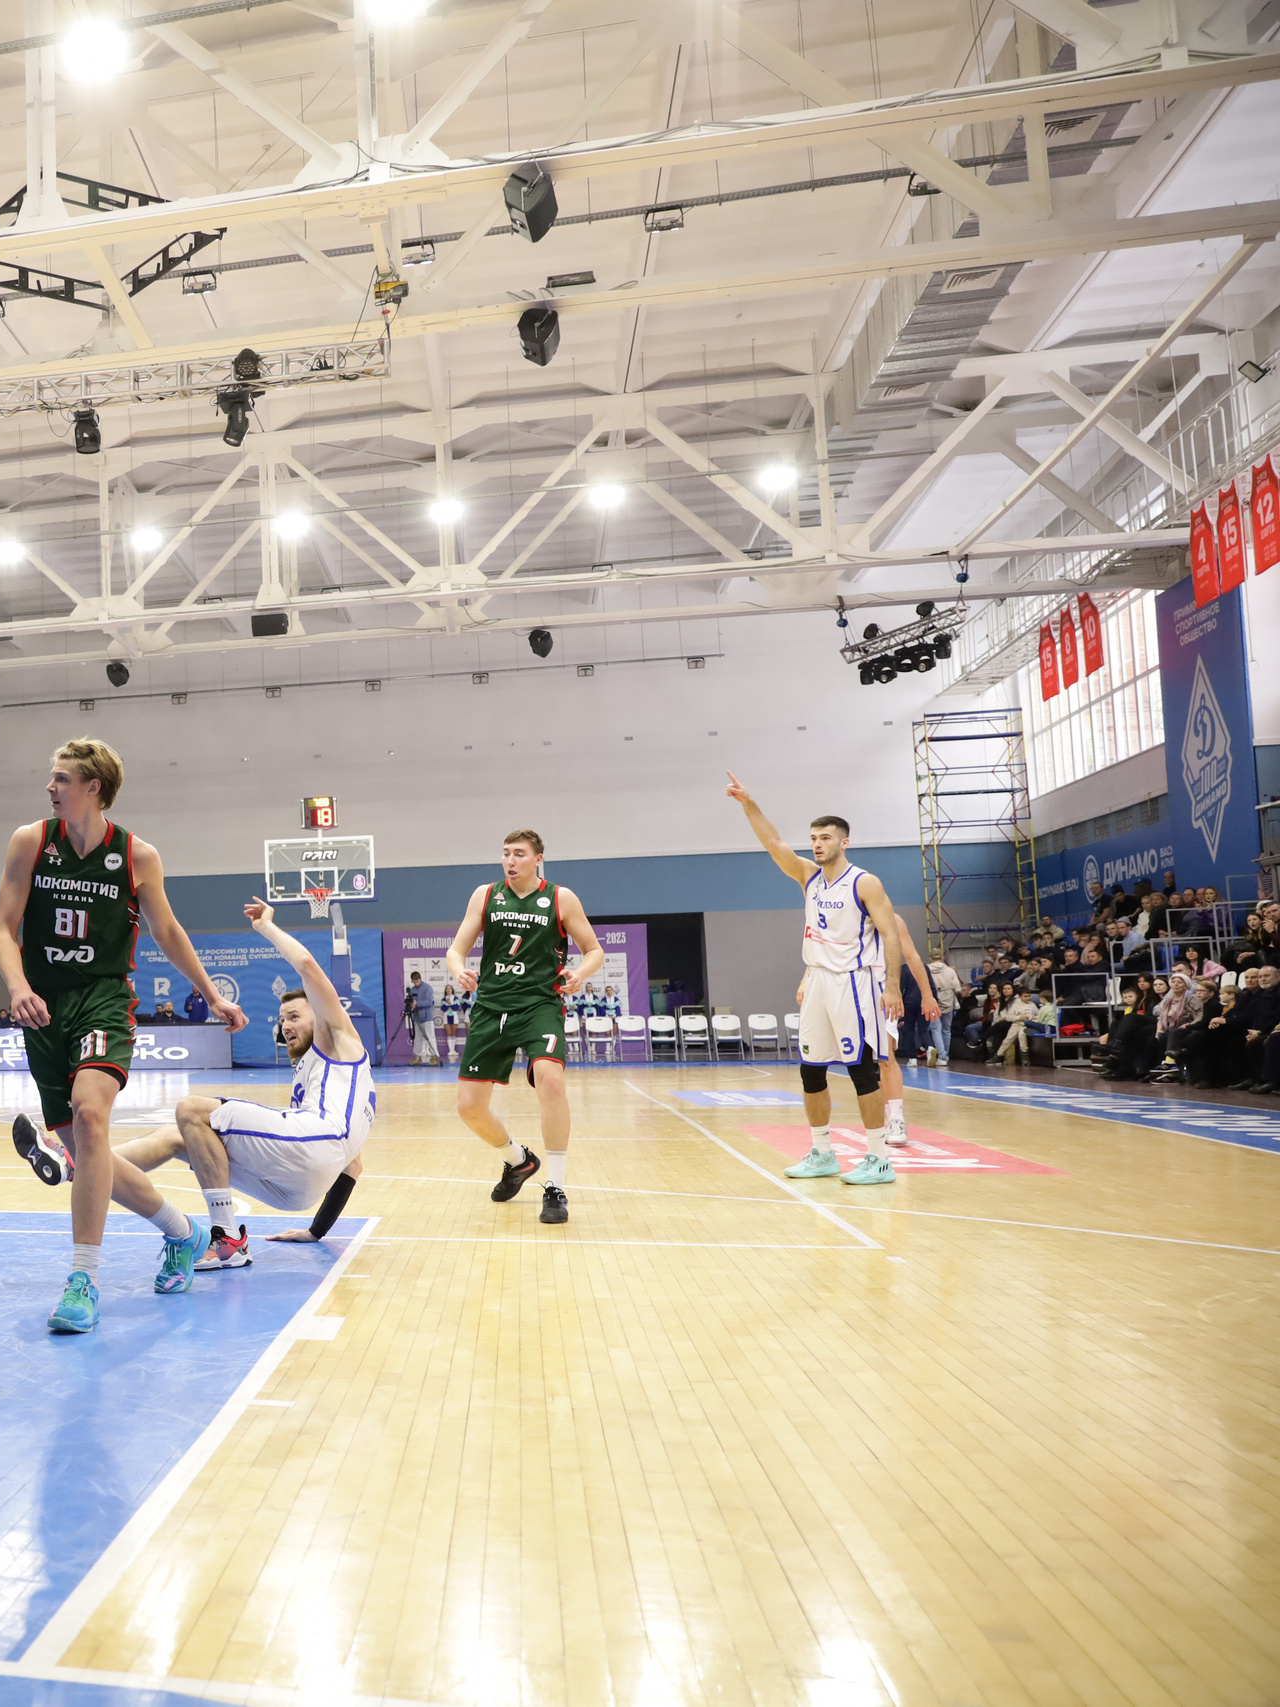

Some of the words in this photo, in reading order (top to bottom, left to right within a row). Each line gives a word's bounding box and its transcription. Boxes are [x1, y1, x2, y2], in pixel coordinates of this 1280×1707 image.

[1256, 492, 1275, 527] 12
[1222, 516, 1238, 549] 15
[1198, 537, 1207, 563] 4
[1085, 615, 1096, 641] 10
[1175, 601, 1220, 635] СПОРТИВНОЕ
[1065, 632, 1071, 655] 8
[1180, 618, 1217, 647] ОБЩЕСТВО
[1042, 646, 1053, 670] 15
[317, 807, 332, 826] 18
[302, 850, 338, 860] PARI
[1103, 849, 1158, 889] ДИНАМО
[34, 874, 119, 900] ЛОКОМОТИВ
[53, 893, 94, 903] КУБАНЬ
[54, 907, 88, 940] 81
[490, 911, 549, 927] ЛОКОМОТИВ
[818, 913, 827, 929] 3
[509, 934, 523, 956] 7
[80, 1029, 107, 1061] 81
[542, 1034, 558, 1054] 7
[841, 1037, 854, 1055] 3
